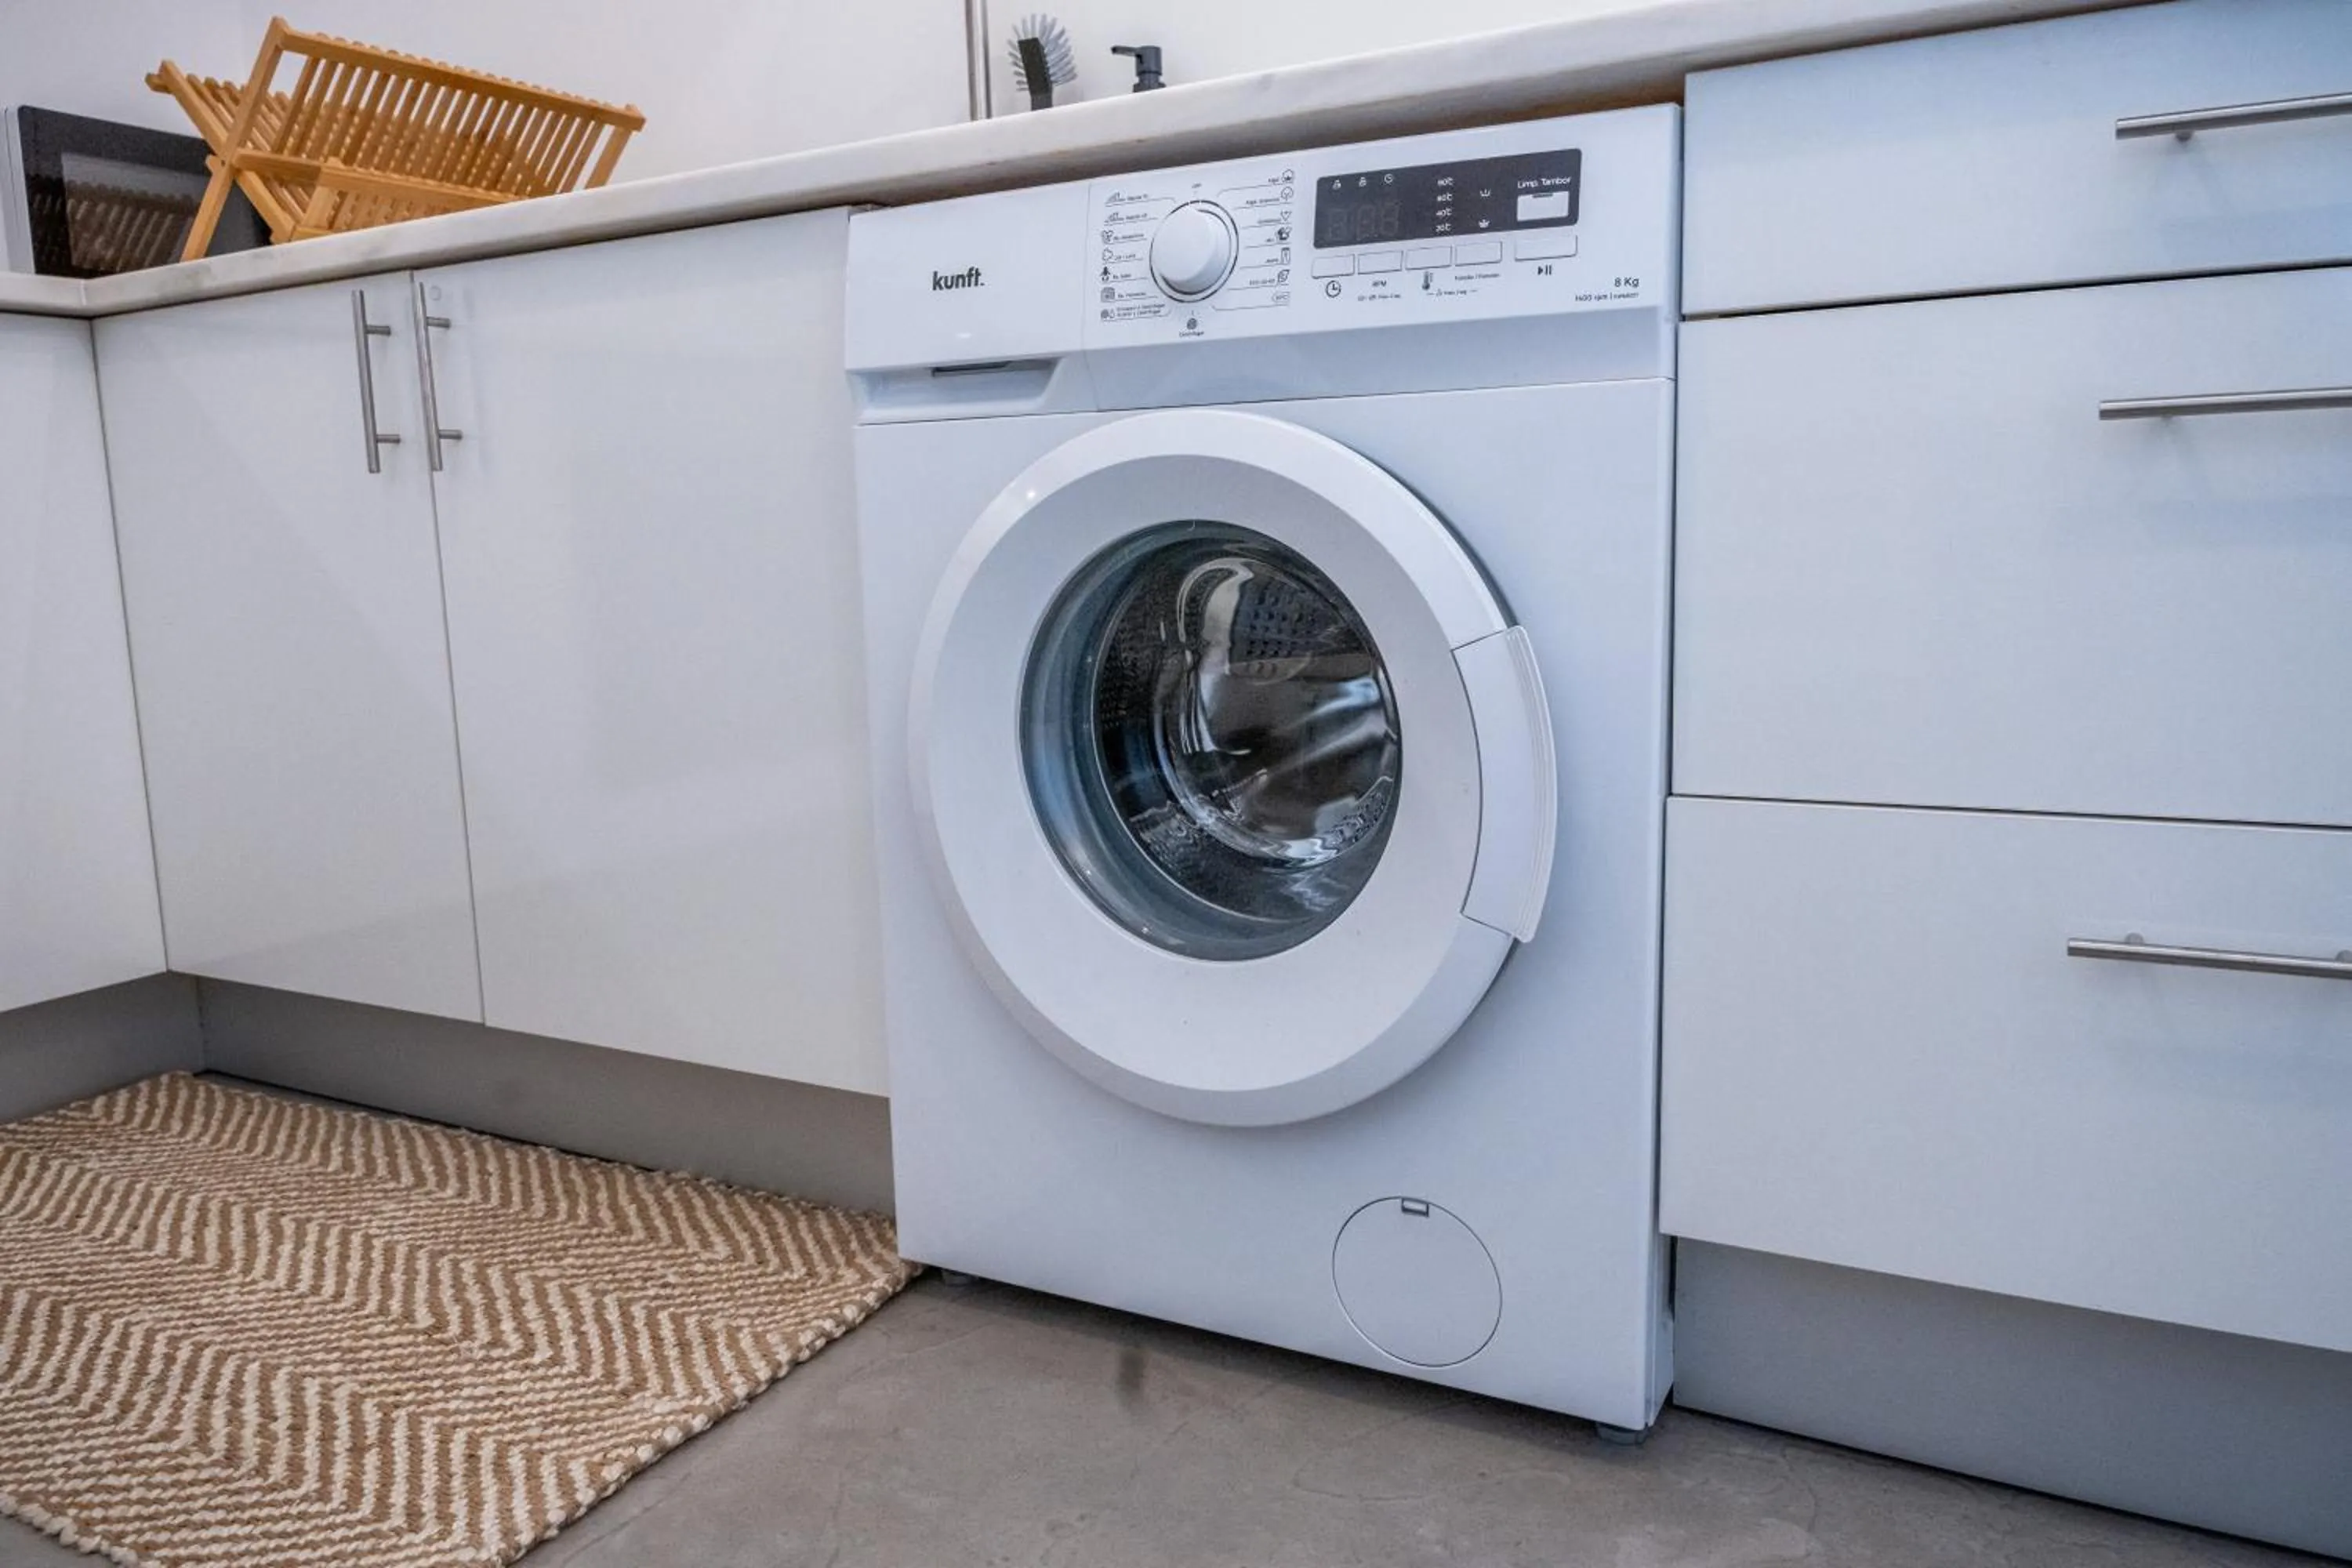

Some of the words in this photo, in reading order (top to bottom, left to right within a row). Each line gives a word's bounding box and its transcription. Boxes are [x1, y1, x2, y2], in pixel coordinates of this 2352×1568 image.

[1541, 176, 1572, 186] Tambor
[1613, 277, 1622, 288] 8
[1624, 276, 1639, 289] Kg
